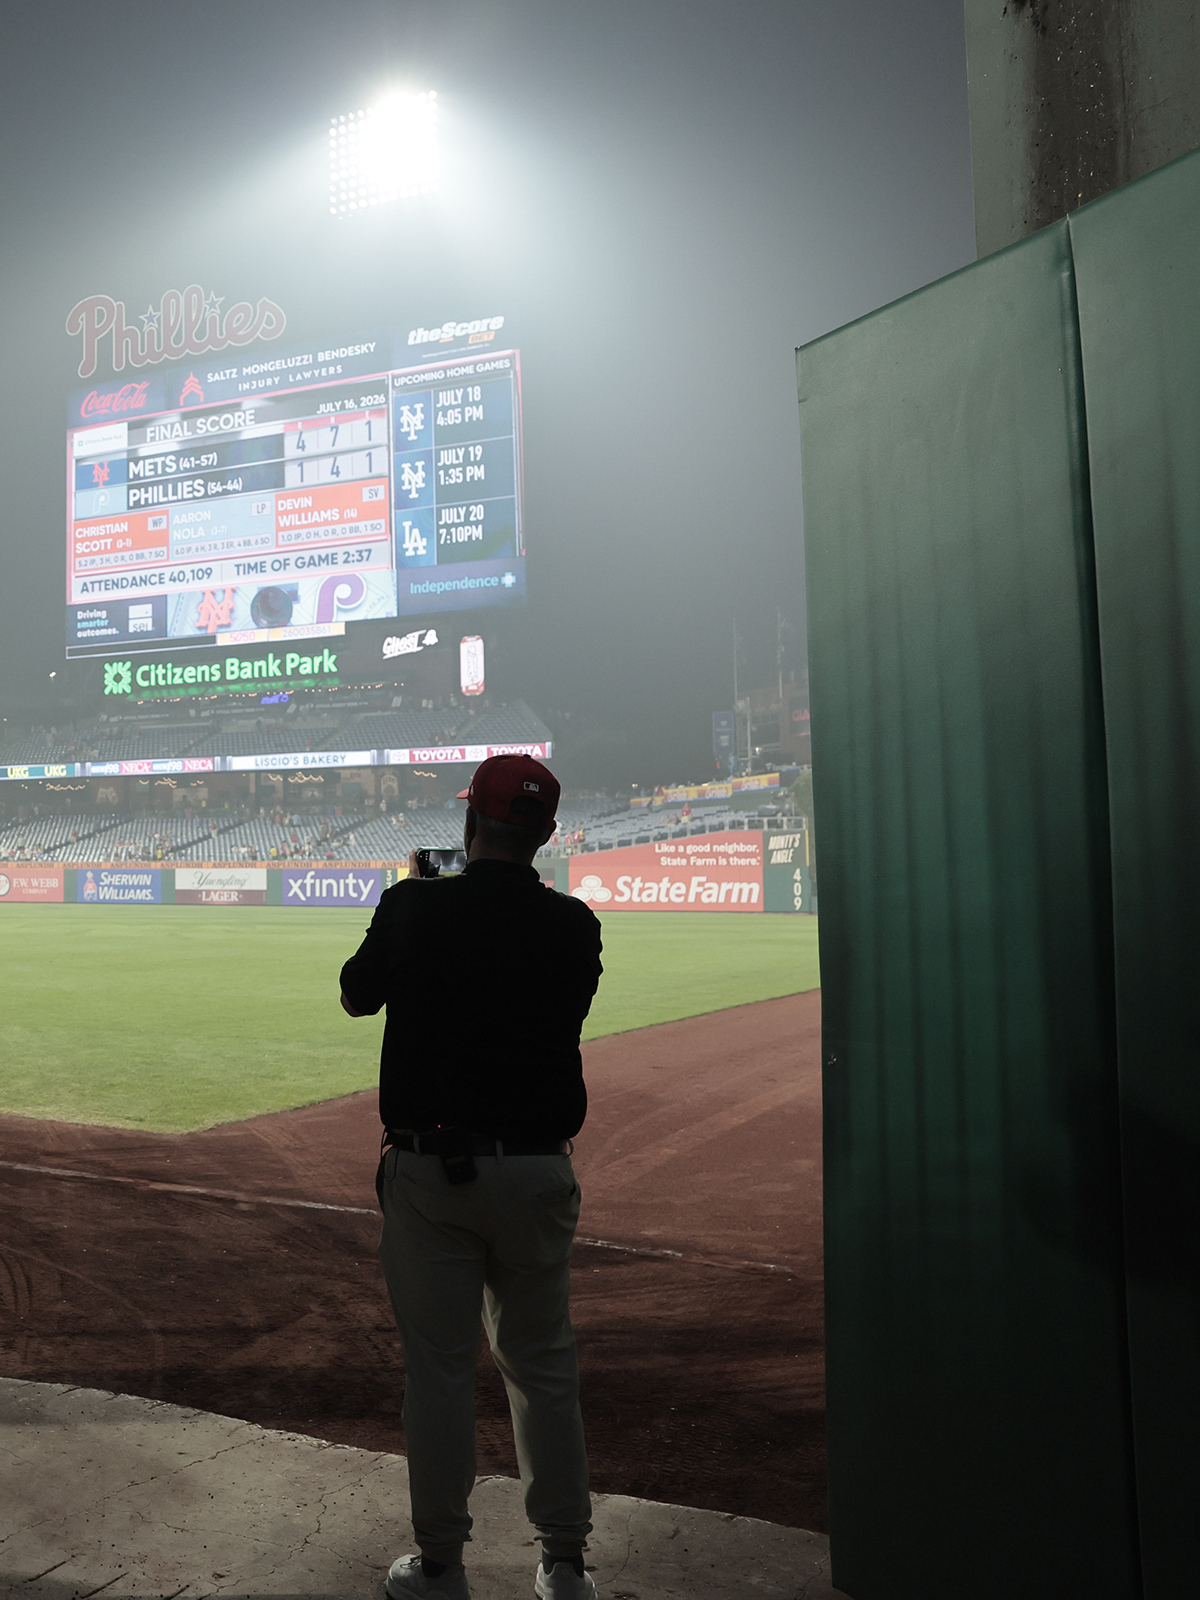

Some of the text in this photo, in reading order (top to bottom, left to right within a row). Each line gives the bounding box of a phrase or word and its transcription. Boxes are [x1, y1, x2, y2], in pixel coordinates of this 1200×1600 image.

[66, 284, 286, 378] Phillies
[407, 316, 504, 346] theScore
[207, 342, 376, 383] SALTZ MONGELUZZI BENDESKY
[238, 364, 343, 391] INJURY LAWYERS
[394, 359, 511, 387] UPCOMING HOME GAMES
[316, 393, 386, 414] JULY 16, 2026
[436, 385, 482, 408] JULY 18
[436, 404, 484, 427] 4:05 PM
[146, 411, 256, 443] FINAL SCORE
[129, 420, 372, 479] METS (41-57) 4 7 1
[437, 445, 483, 466] JULY 19
[129, 452, 373, 507] PHILLIES (54-44) 1 4 1
[438, 464, 485, 486] 1:35 PM
[368, 488, 379, 499] SV
[256, 503, 266, 514] LP
[278, 496, 313, 511] DEVIN
[151, 517, 163, 529] WP
[172, 510, 211, 526] AARON
[278, 508, 340, 527] WILLIAMS
[438, 504, 484, 526] JULY 20
[75, 522, 129, 539] CHRISTIAN
[172, 526, 206, 541] NOLA
[370, 522, 382, 532] SO
[439, 524, 484, 545] 7:10PM
[75, 538, 113, 554] SCOTT
[402, 520, 427, 557] LA
[235, 549, 372, 576] TIME OF GAME 2:37
[80, 567, 213, 594] ATTENDANCE 40,109
[410, 576, 499, 594] Independence
[77, 609, 107, 620] Driving
[77, 618, 109, 629] smarter
[77, 627, 120, 638] outcomes.
[382, 629, 427, 660] GHOST
[135, 648, 338, 687] Citizens Bank Park
[792, 708, 810, 721] GIA
[254, 754, 347, 768] LISCIO'S BAKERY
[412, 744, 543, 761] TOYOTA TOYOTA
[7, 766, 30, 778] UKG
[44, 765, 67, 777] UKG
[121, 761, 151, 774] NECA
[184, 758, 214, 771] NECA
[655, 842, 676, 853] Like
[686, 842, 711, 855] good
[713, 842, 759, 855] neighbor,
[660, 857, 687, 866] State
[690, 856, 716, 866] Farm
[718, 856, 727, 866] is
[31, 878, 59, 888] WEBB
[99, 872, 152, 886] SHERWIN
[287, 871, 374, 901] xfinity
[99, 887, 154, 900] WILLIAMS.
[202, 891, 239, 902] LAGER
